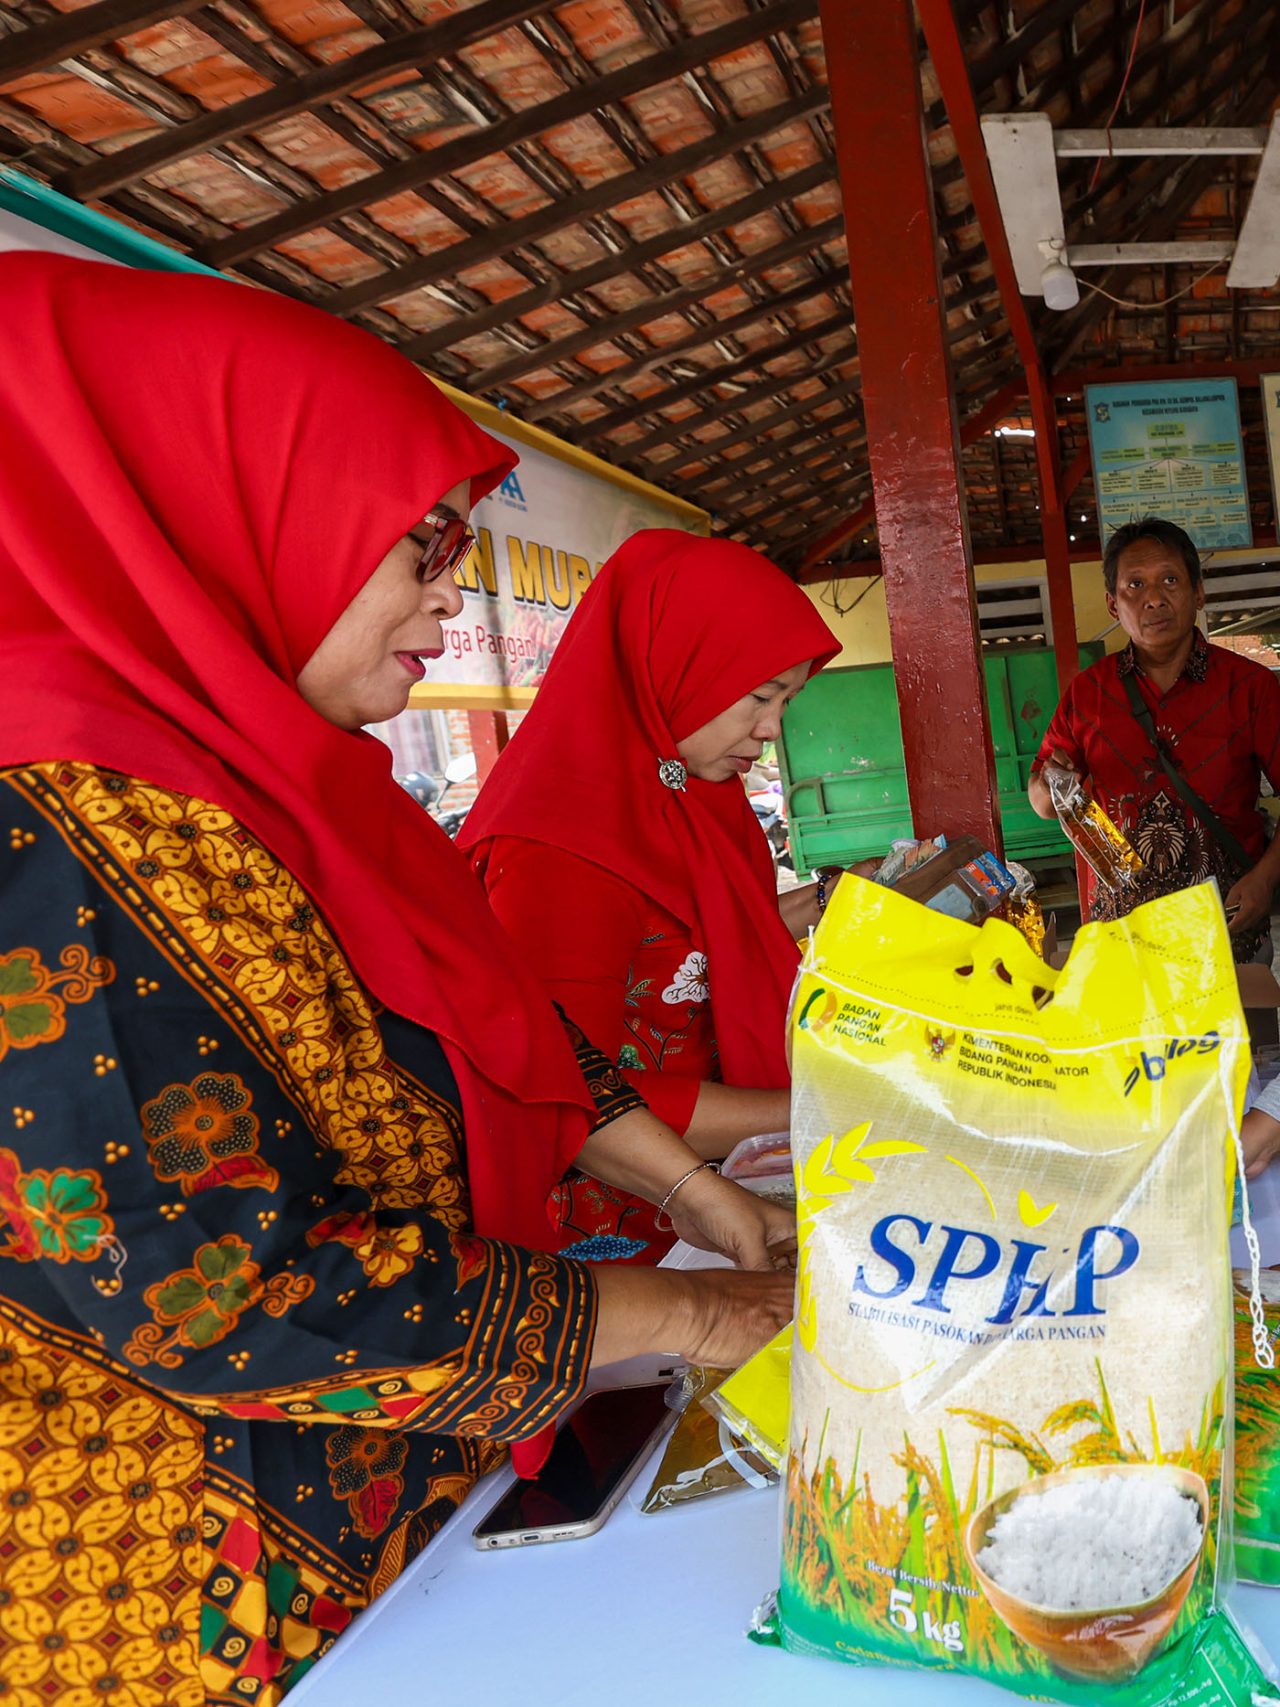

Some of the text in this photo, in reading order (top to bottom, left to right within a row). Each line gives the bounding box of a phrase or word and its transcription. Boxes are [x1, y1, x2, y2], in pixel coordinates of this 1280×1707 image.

[506, 534, 604, 612] MUR
[475, 625, 534, 664] Pangan
[837, 1013, 881, 1032] PANGAN
[842, 1003, 881, 1020] BADAN
[833, 1024, 887, 1047] NASIONAL
[958, 1059, 1003, 1080] REPUBLIK
[960, 1046, 1032, 1075] BIDANG PANGAN
[1048, 1325, 1107, 1341] PANGAN
[890, 1588, 964, 1652] 5 kg
